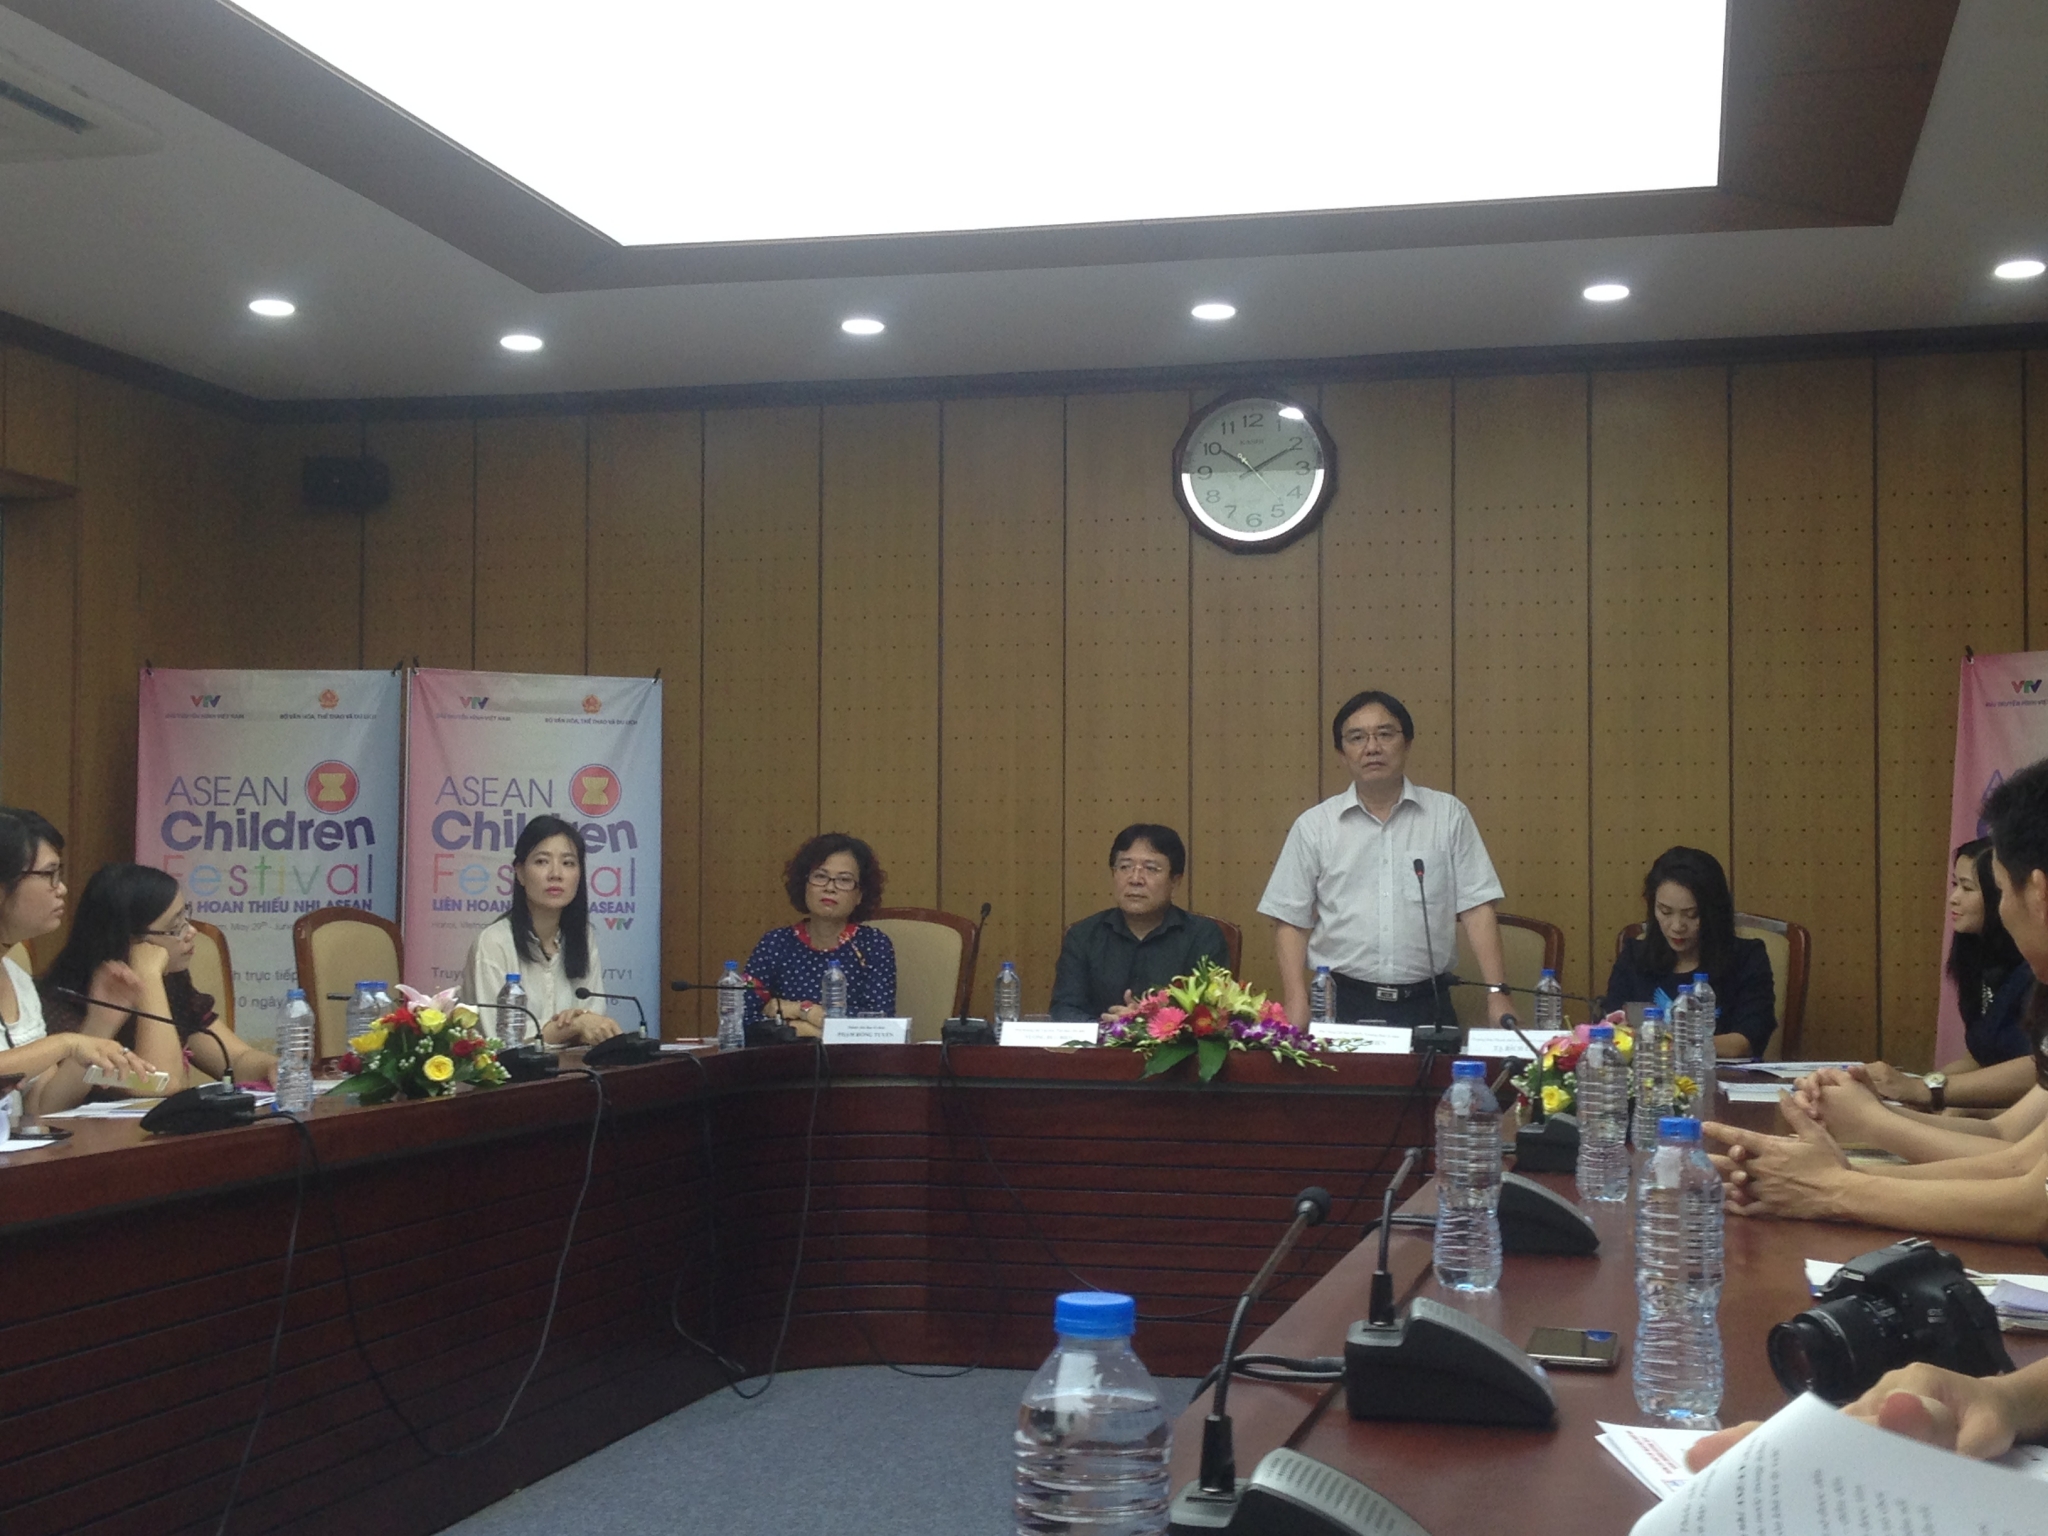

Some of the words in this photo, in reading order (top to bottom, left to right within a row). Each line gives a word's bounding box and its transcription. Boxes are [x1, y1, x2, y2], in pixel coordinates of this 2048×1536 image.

[1221, 421, 1235, 435] 11
[1243, 413, 1264, 428] 12
[1276, 419, 1282, 432] 1
[1203, 441, 1222, 456] 10
[1289, 436, 1303, 451] 2
[1197, 465, 1213, 480] 9
[1295, 461, 1310, 476] 3
[1206, 489, 1221, 504] 8
[1286, 485, 1303, 499] 4
[1225, 504, 1237, 519] 7
[1270, 504, 1285, 518] 5
[1245, 513, 1262, 528] 6
[2011, 679, 2043, 694] VTV
[190, 694, 222, 708] VTV
[460, 696, 489, 709] VTV
[165, 775, 288, 806] ASEAN
[435, 775, 553, 808] ASEAN
[161, 808, 376, 852] Children
[431, 809, 638, 854] Chilen
[162, 853, 373, 897] Festival
[432, 853, 636, 898] Fesal
[197, 900, 244, 914] HOAN
[249, 897, 289, 914] THIẾU
[294, 900, 320, 913] NHI
[432, 896, 462, 912] LIÊN
[466, 899, 512, 913] HOAN
[588, 901, 636, 914] ASEAN
[605, 917, 634, 931] VTV
